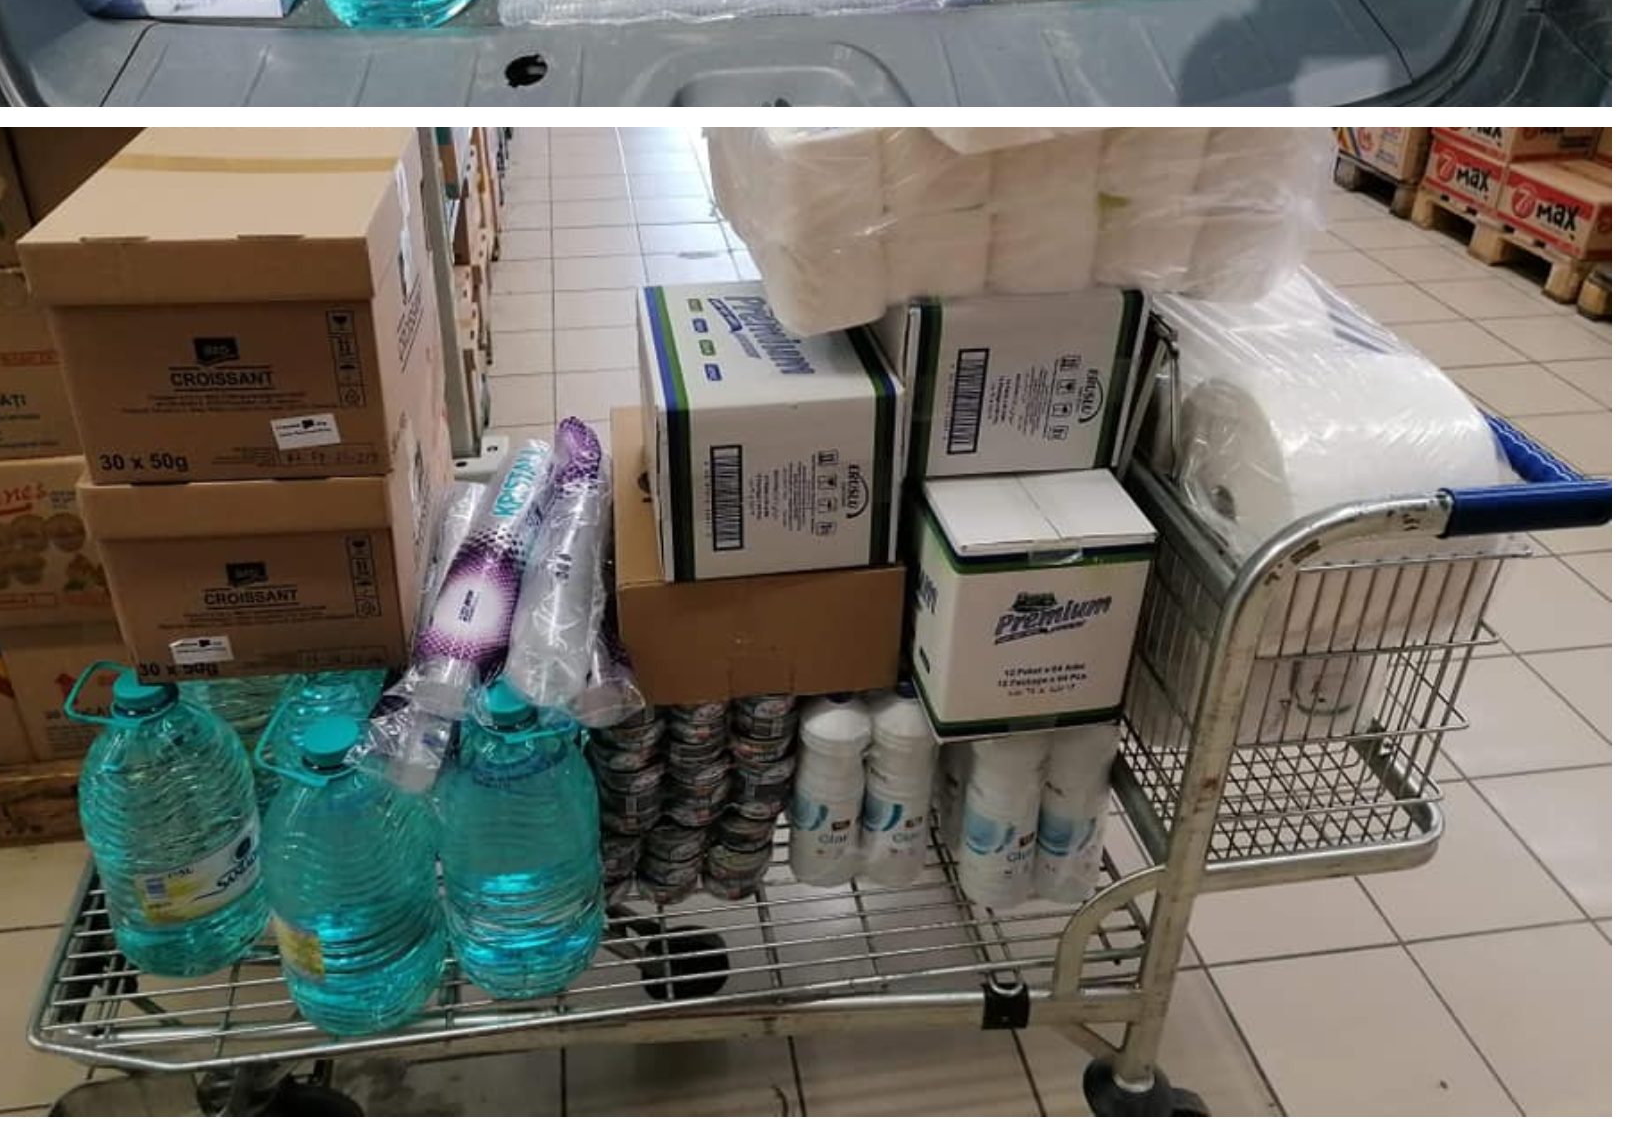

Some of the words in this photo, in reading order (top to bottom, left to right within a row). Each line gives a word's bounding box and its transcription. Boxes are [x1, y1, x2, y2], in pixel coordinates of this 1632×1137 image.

[170, 370, 274, 387] CROISSANT
[99, 453, 124, 471] 30
[130, 457, 144, 470] x
[149, 452, 189, 473] 50g
[995, 595, 1112, 636] Premium
